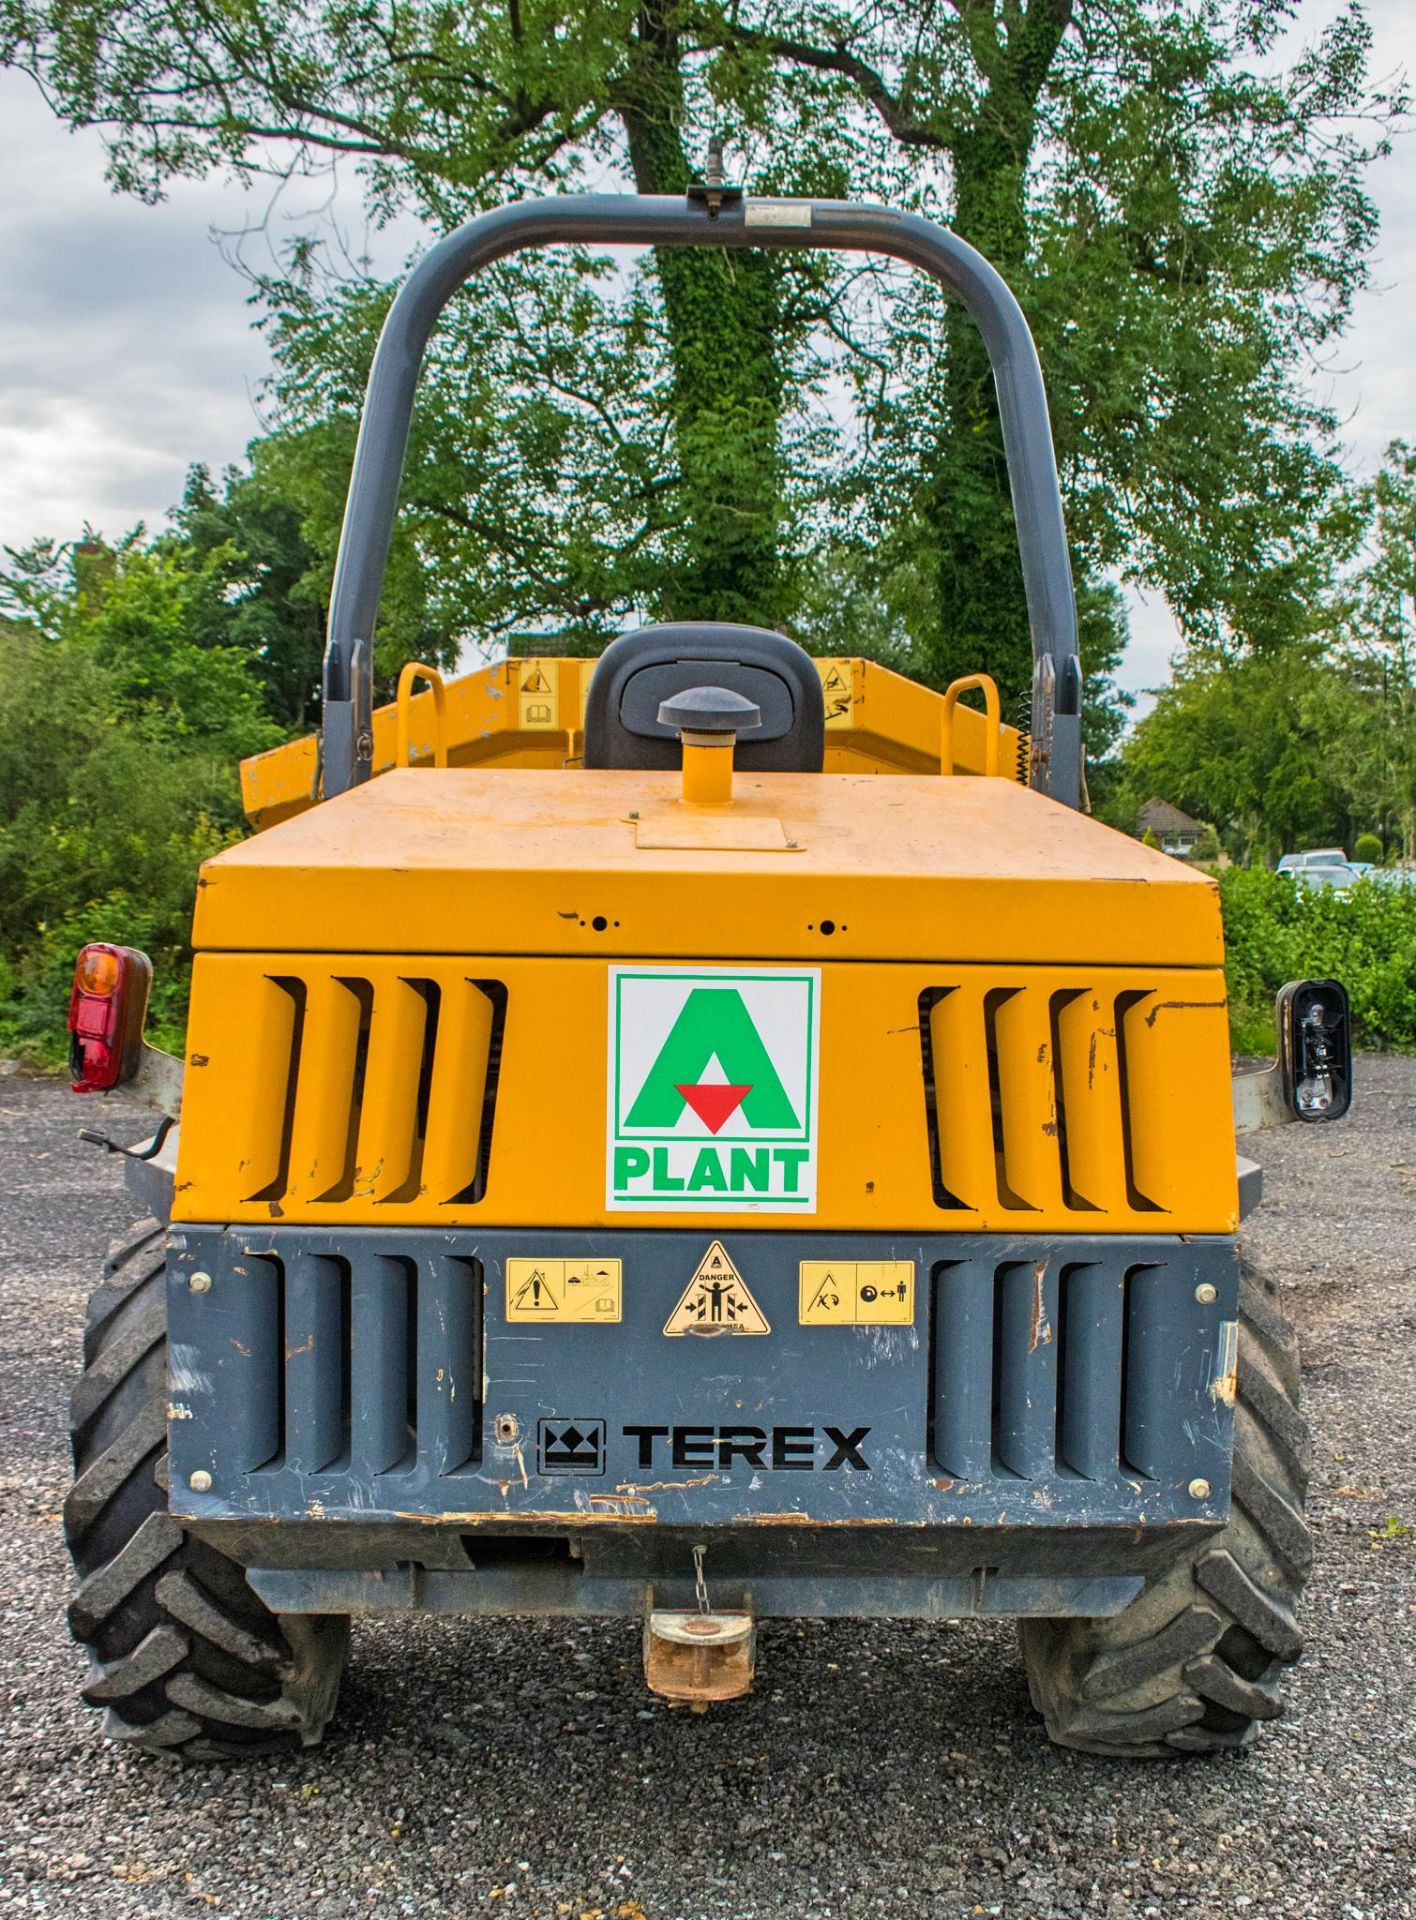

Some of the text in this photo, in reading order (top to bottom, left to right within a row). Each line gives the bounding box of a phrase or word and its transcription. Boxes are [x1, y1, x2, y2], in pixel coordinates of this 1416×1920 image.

[623, 988, 802, 1130] A
[613, 1146, 810, 1193] PLANT
[622, 1425, 873, 1471] TEREX
